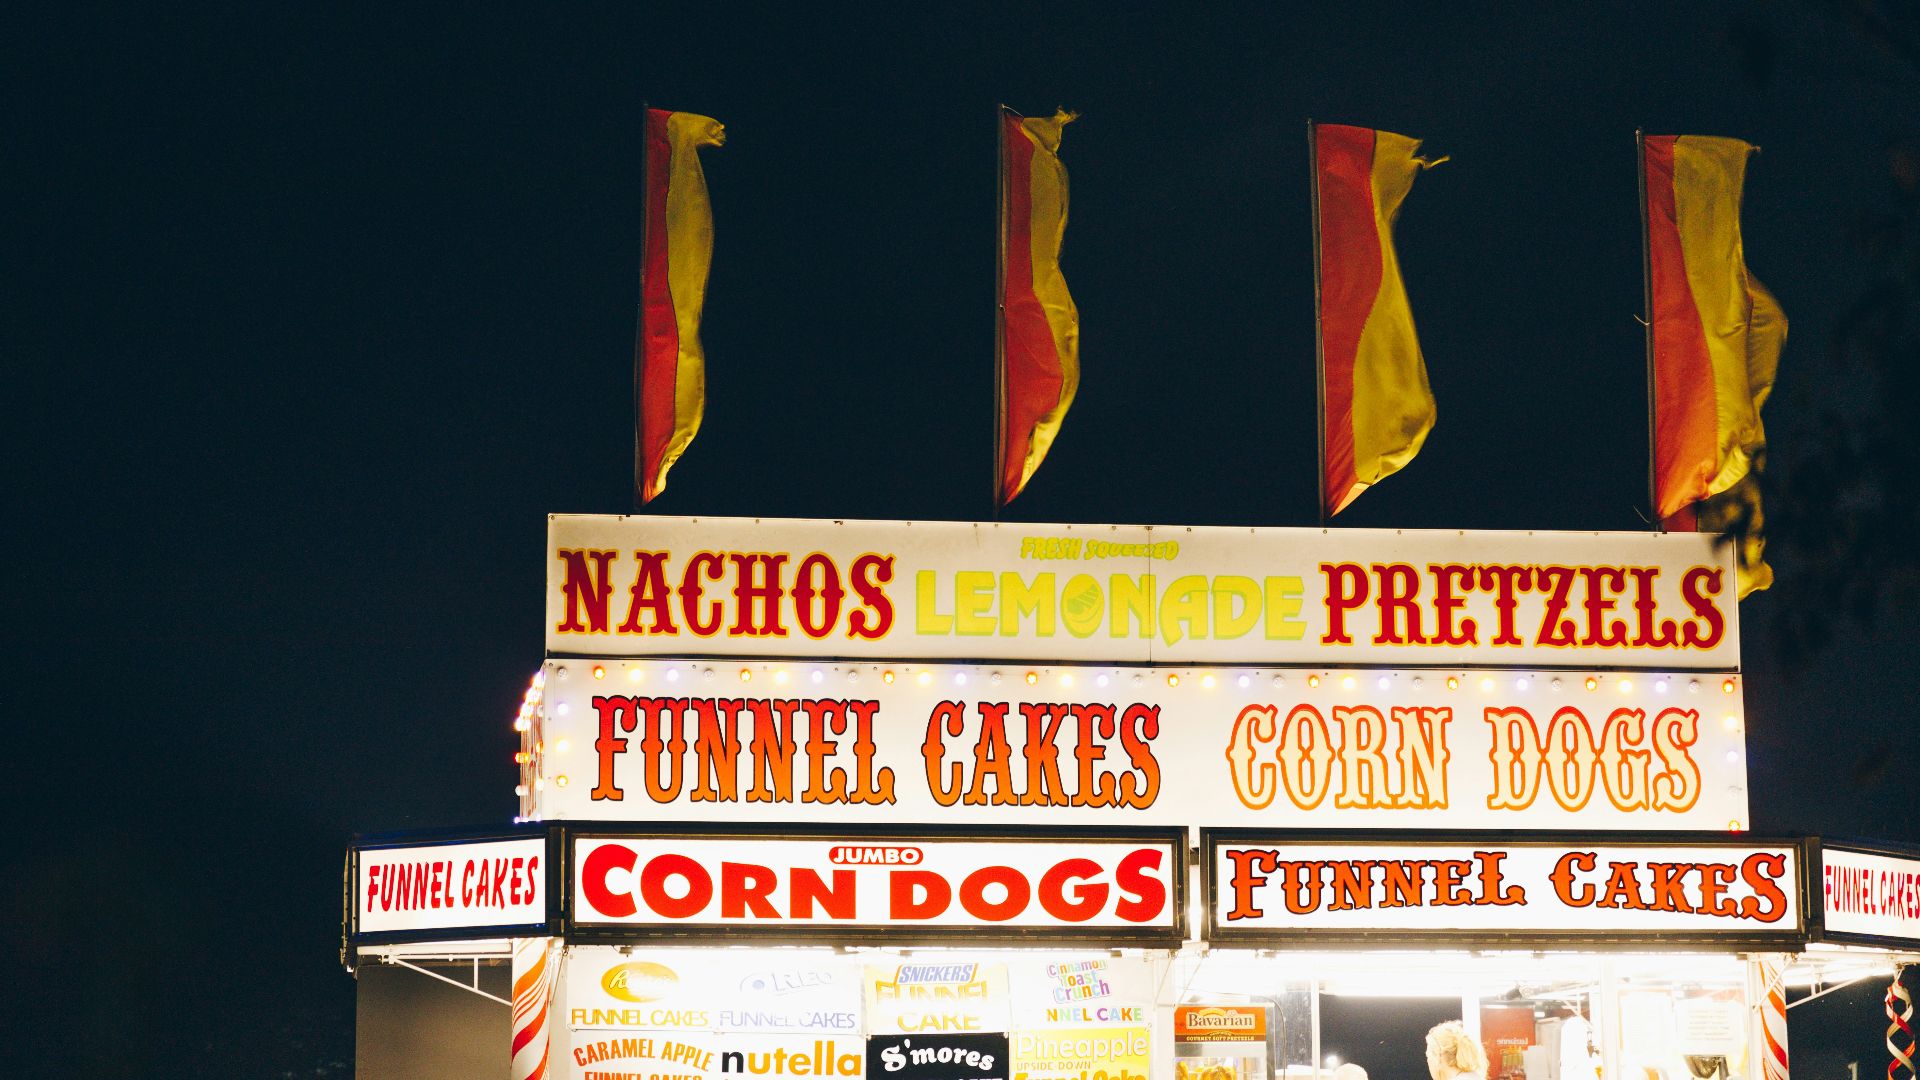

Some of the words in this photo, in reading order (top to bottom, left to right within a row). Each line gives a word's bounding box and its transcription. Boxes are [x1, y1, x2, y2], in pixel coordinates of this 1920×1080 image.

[1020, 536, 1082, 561] FRESH
[1084, 538, 1179, 561] SQUEEZED
[556, 547, 896, 641] NACHOS
[916, 570, 1308, 647] LEMONADE
[1318, 561, 1727, 652] PRETZELS
[591, 695, 897, 805] FUNNEL
[921, 700, 1161, 811] CAKES
[1225, 703, 1453, 811] CORN
[1484, 705, 1701, 812] DOGS
[833, 847, 921, 864] JUMBO
[367, 861, 454, 913] FUNNEL
[462, 855, 538, 910] CAKES
[582, 844, 856, 919] CORN
[890, 848, 1166, 922] DOGS
[1226, 849, 1526, 921] FUNNEL
[1549, 851, 1788, 923] CAKES
[1825, 865, 1876, 914] FUNNEL
[1880, 871, 1920, 920] CAKES
[898, 964, 973, 984] SNICKERS
[1048, 960, 1107, 976] Cinnamon
[1055, 979, 1110, 1002] Crunch
[571, 1008, 647, 1026] FUNNEL
[650, 1010, 709, 1027] CAKES
[719, 1010, 796, 1027] FUNNEL
[799, 1012, 856, 1029] CAKES
[897, 1012, 982, 1032] CAKE
[1096, 1007, 1143, 1021] CAKE
[1188, 1012, 1253, 1027] Bavarian
[573, 1038, 655, 1067] CARAMEL
[661, 1041, 715, 1072] APPLE
[722, 1040, 862, 1076] nutella
[881, 1038, 995, 1072] S'mores
[1016, 1031, 1147, 1062] Pineapple
[1016, 1061, 1054, 1071] UPSIDE
[1058, 1060, 1091, 1070] DOWN
